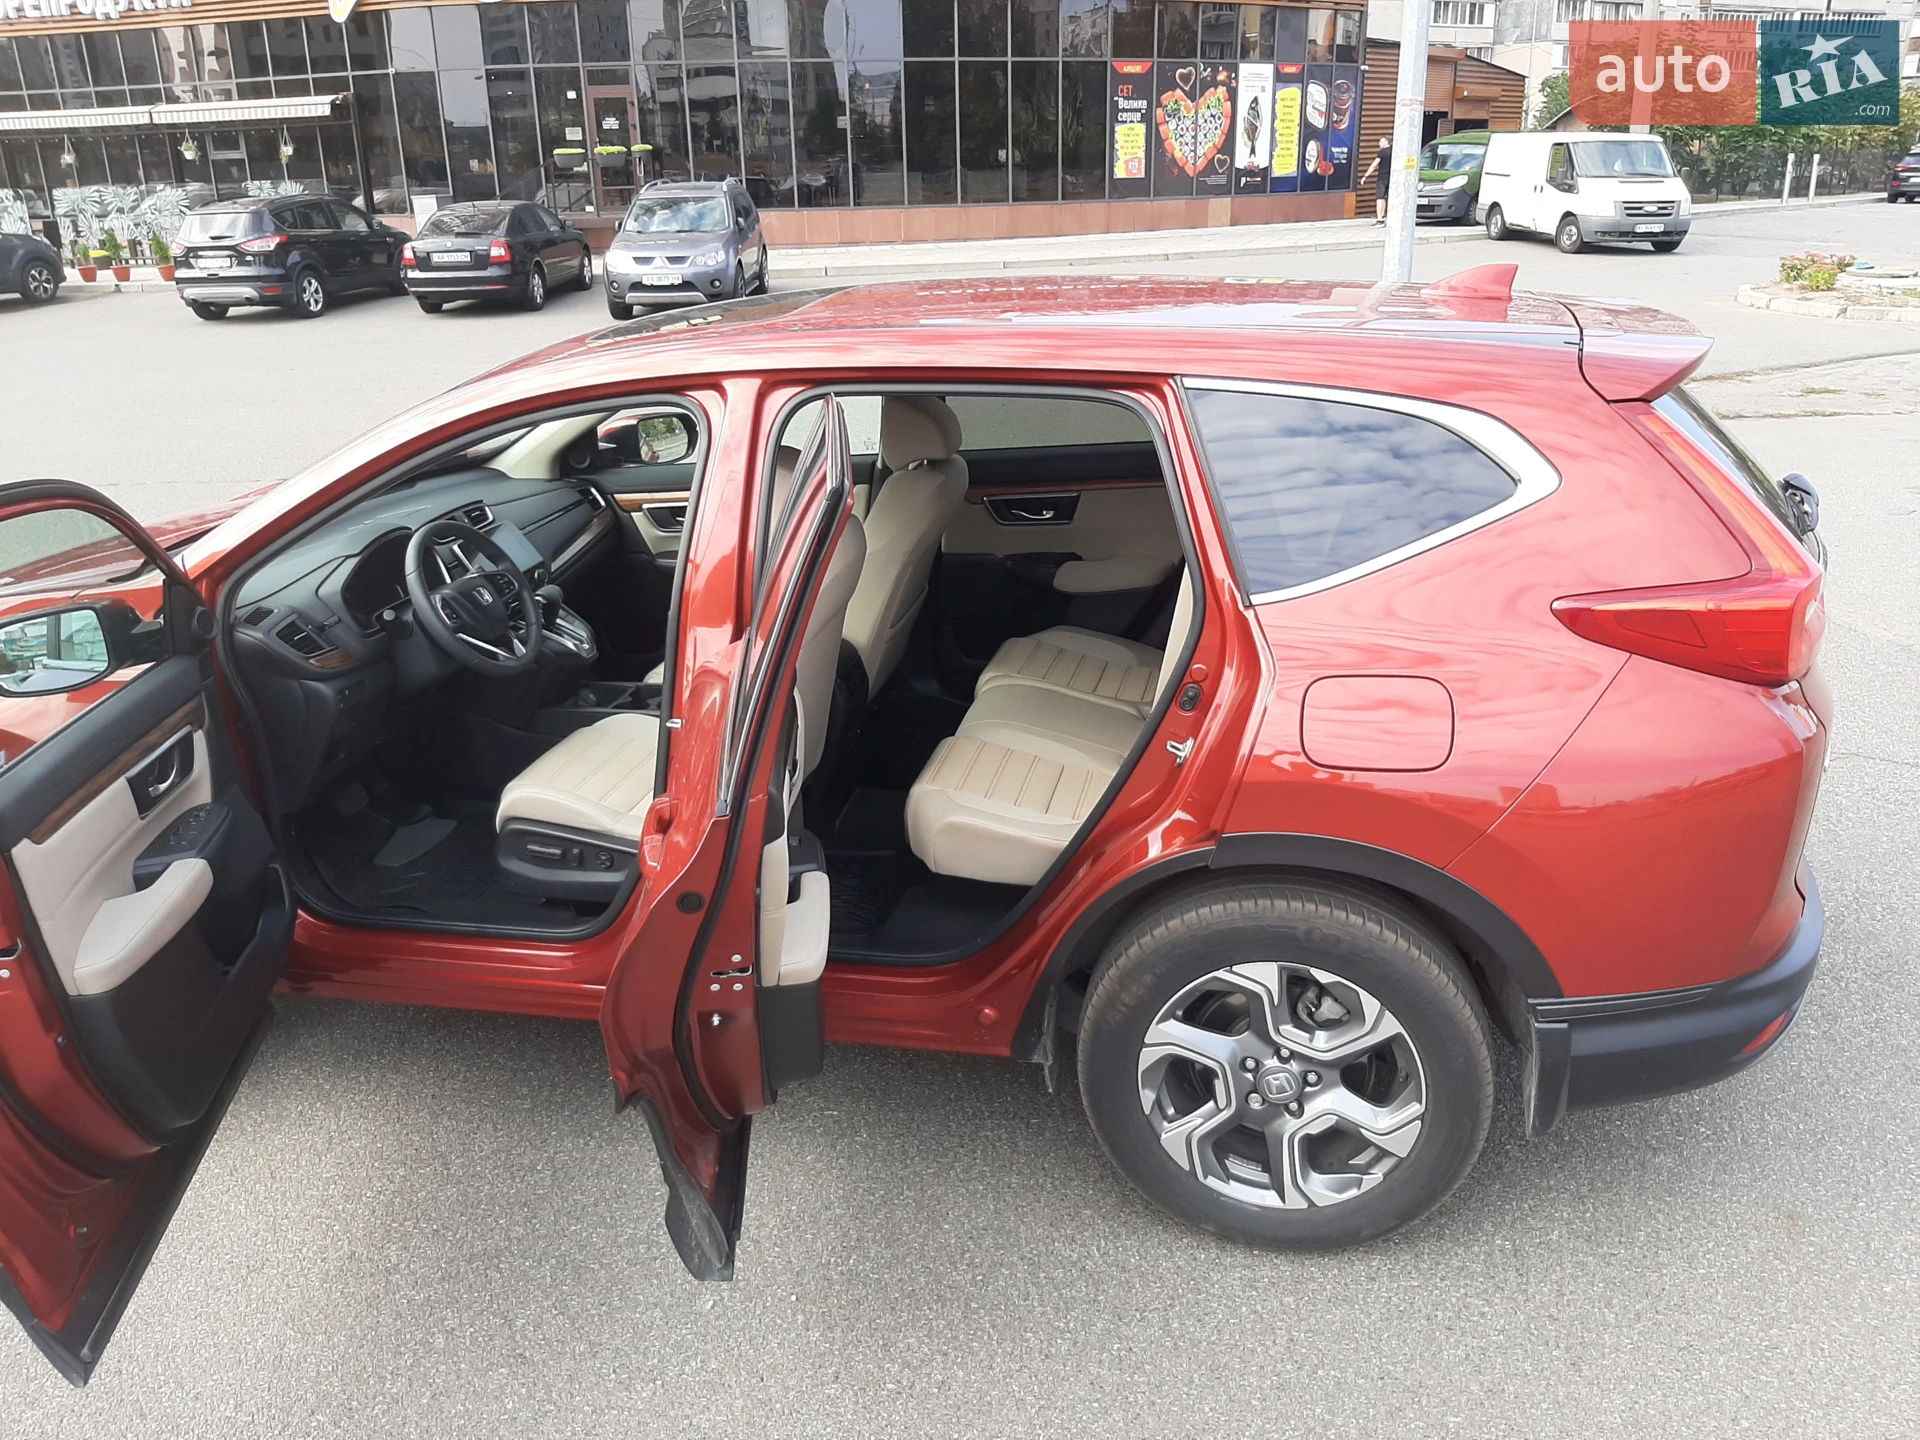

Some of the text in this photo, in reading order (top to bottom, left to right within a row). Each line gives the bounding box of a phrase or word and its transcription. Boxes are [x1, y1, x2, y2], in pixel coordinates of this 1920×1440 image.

[1118, 84, 1134, 97] СЕТ
[1113, 96, 1148, 109] "Велике
[1117, 109, 1146, 124] серце"
